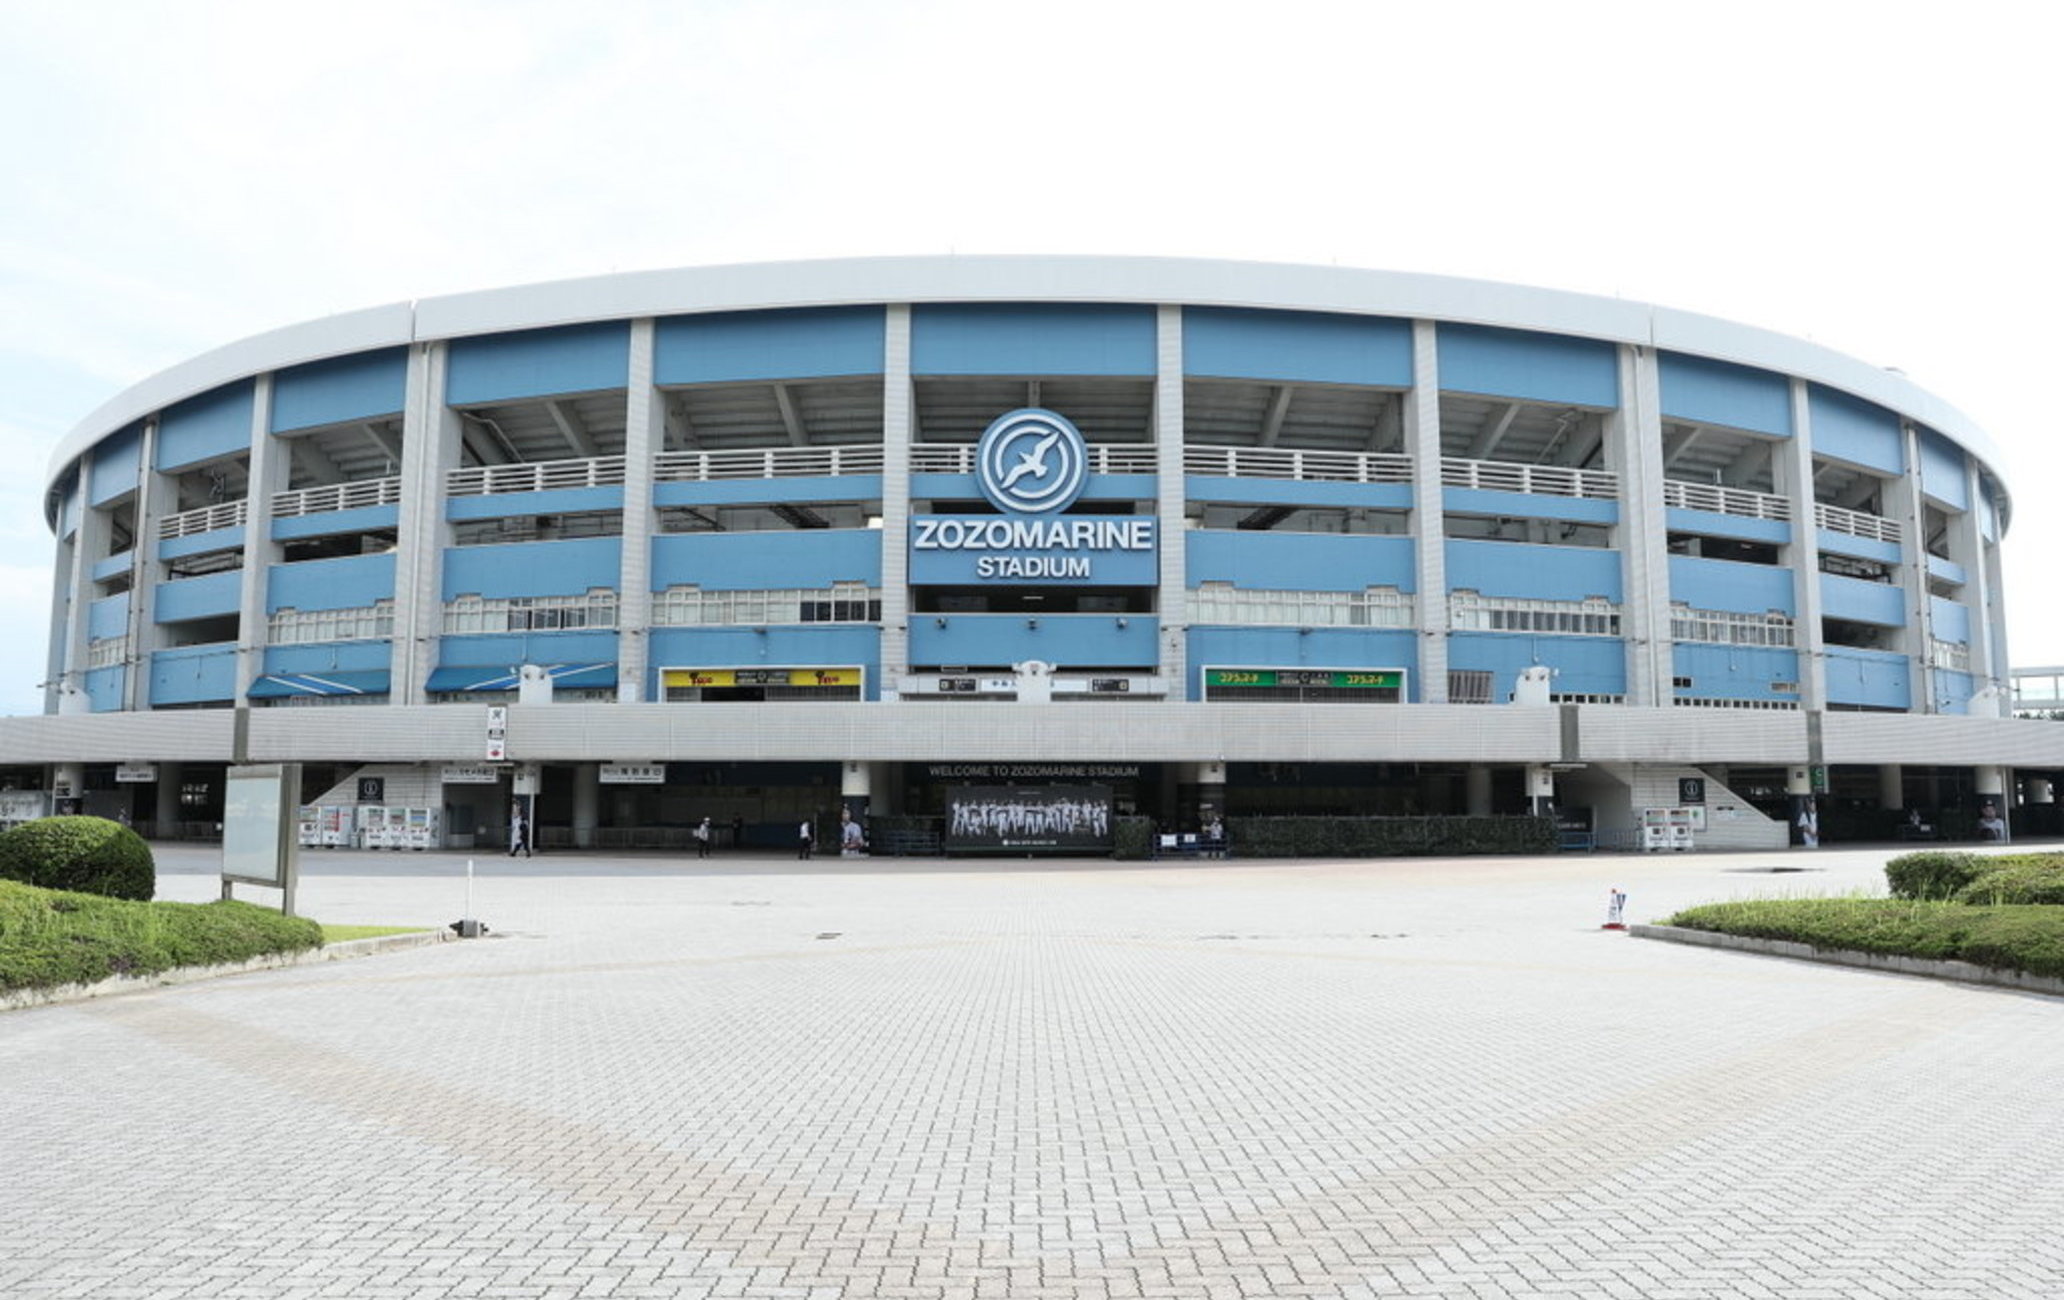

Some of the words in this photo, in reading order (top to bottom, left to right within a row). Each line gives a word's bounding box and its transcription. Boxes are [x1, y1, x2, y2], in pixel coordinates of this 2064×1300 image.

[914, 518, 1153, 550] ZOZOMARINE
[976, 555, 1091, 578] STADIUM
[929, 765, 990, 777] WELCOME
[993, 765, 1009, 777] TO
[1011, 765, 1086, 777] ZOZOMARINE
[1089, 765, 1140, 777] STADIUM
